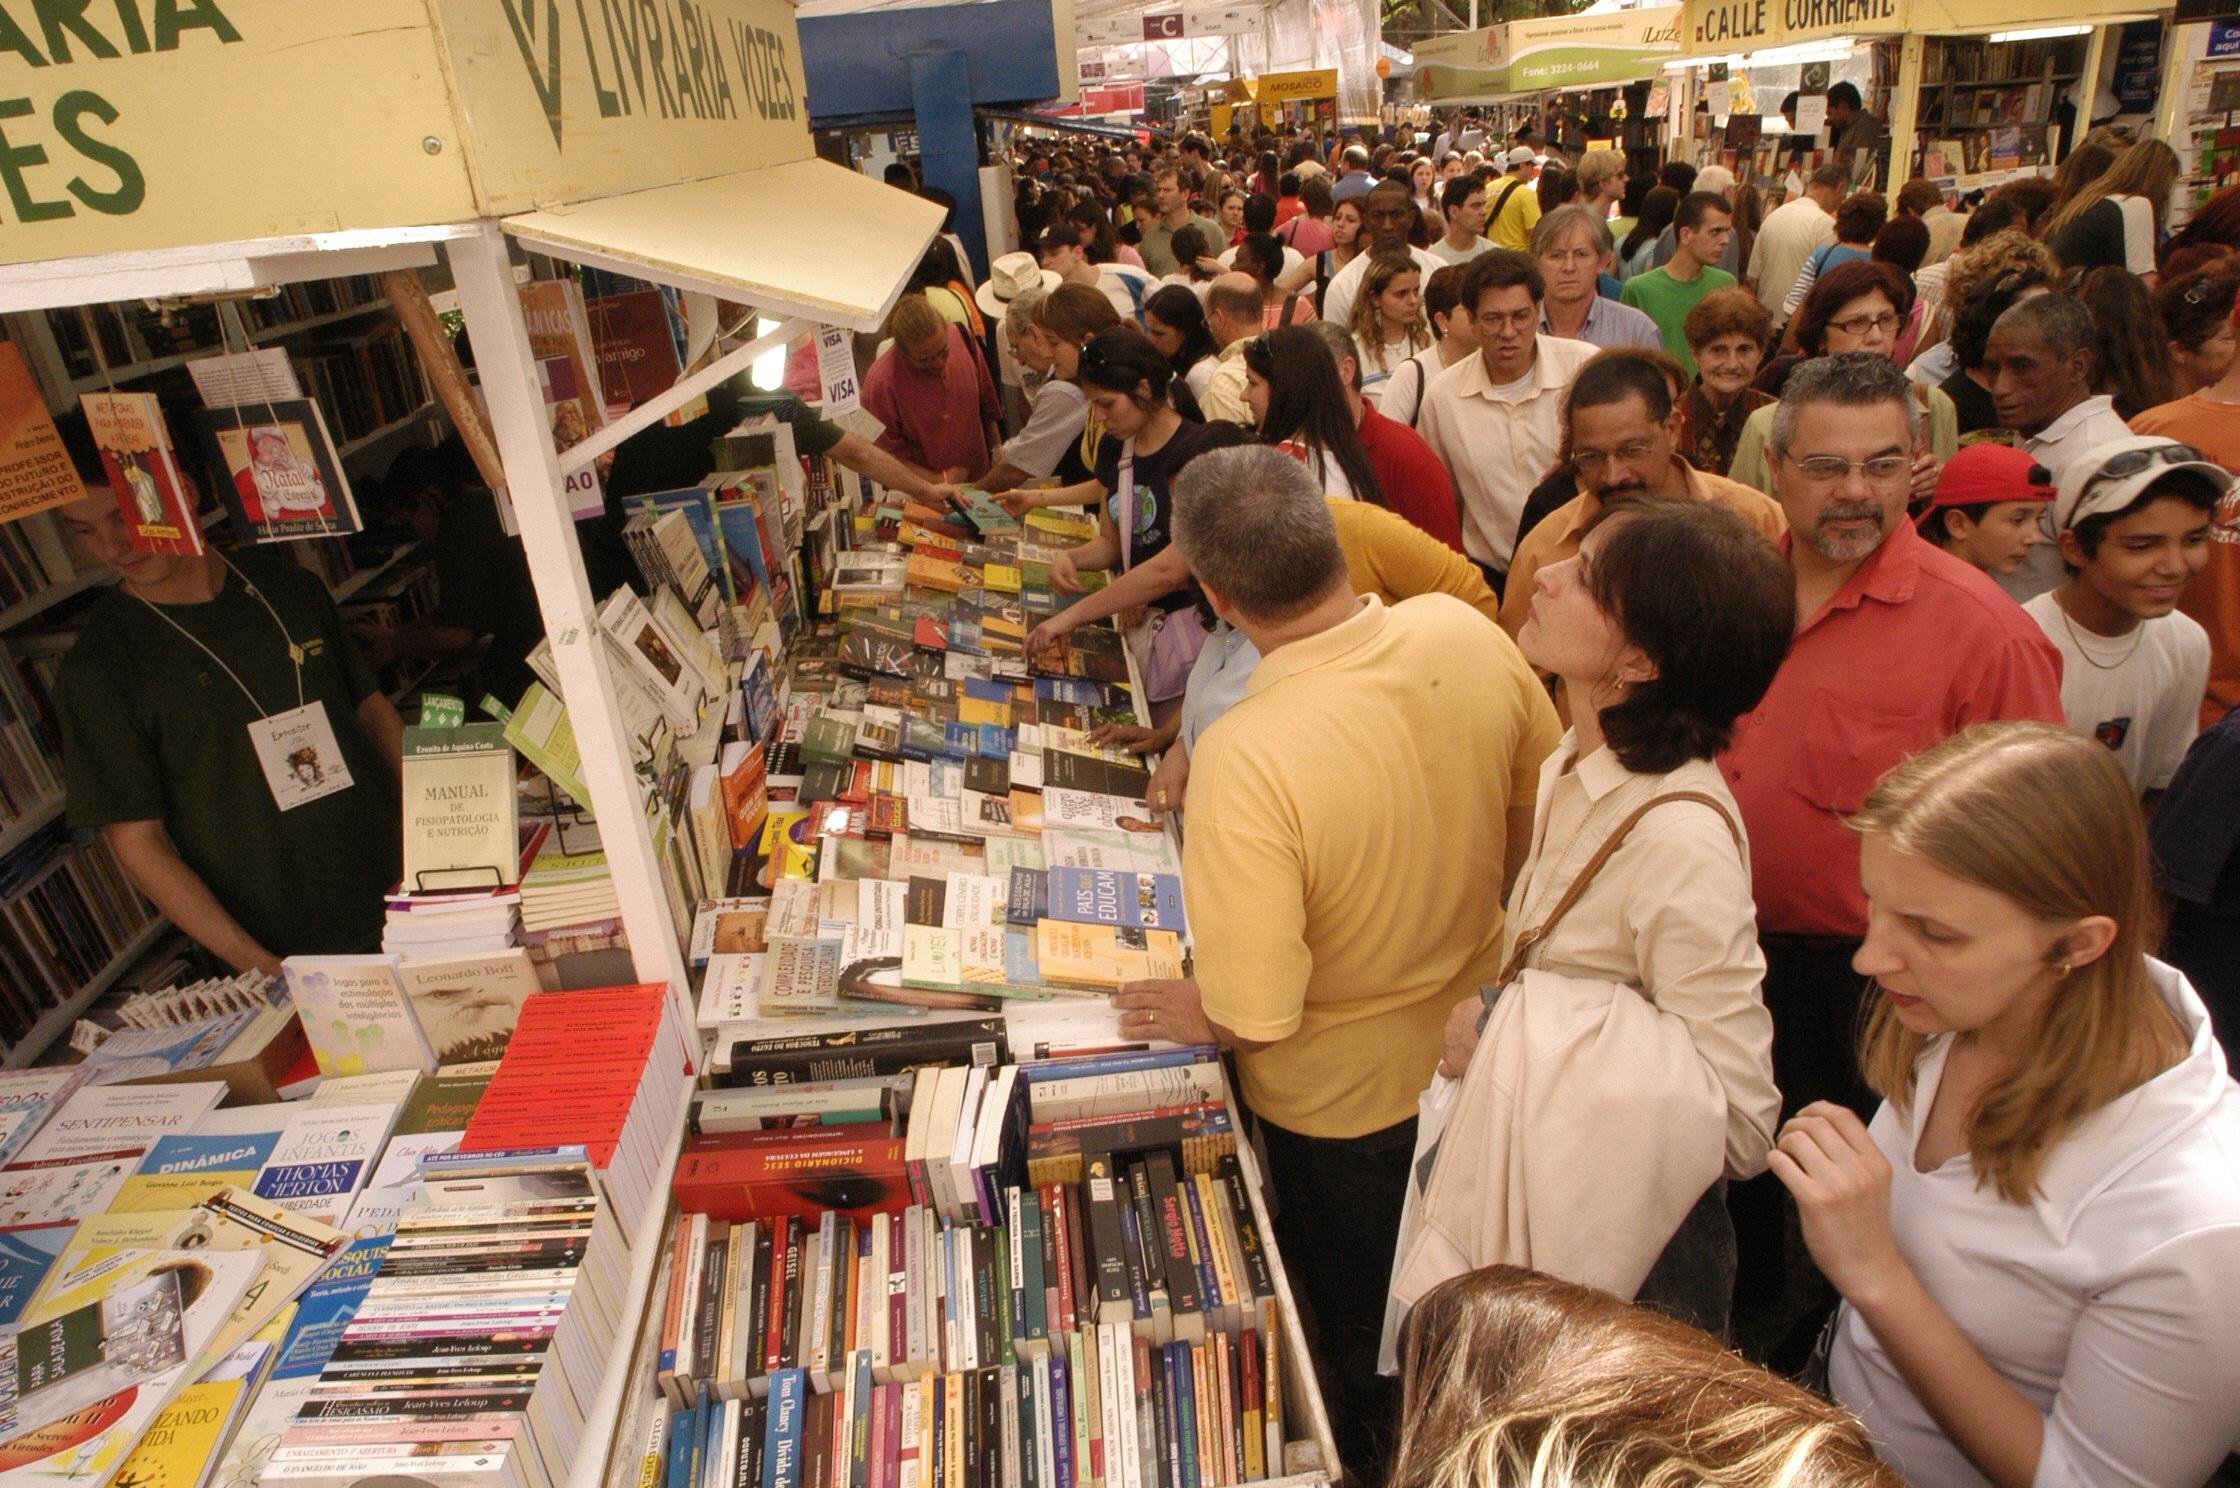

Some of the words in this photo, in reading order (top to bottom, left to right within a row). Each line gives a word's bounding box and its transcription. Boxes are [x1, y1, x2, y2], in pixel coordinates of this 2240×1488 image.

[1161, 16, 1177, 36] C
[1704, 0, 1766, 43] CALLE
[1785, 0, 1895, 31] CORRIENTE
[576, 0, 738, 120] LIVRARIA
[726, 17, 797, 122] VOZES
[1522, 64, 1548, 77] Fone:
[1269, 80, 1323, 94] MOSAICO
[822, 332, 842, 349] VISA
[605, 346, 646, 364] amigo
[829, 378, 855, 403] VISA
[15, 464, 58, 482] FUTURO
[56, 473, 73, 485] DO
[425, 783, 489, 801] MANUAL
[450, 802, 464, 813] DE
[415, 813, 500, 827] FISIOPATOLOGIA
[427, 828, 435, 838] E
[437, 825, 489, 838] NUTRIÇÃO
[1077, 890, 1094, 915] PAIS
[1096, 871, 1118, 921] EDUCAM
[416, 969, 481, 985] Leonardo
[484, 963, 514, 976] Boff
[774, 942, 798, 997] COMPLEXIDADE
[797, 947, 816, 985] PESQUISA
[333, 978, 358, 988] Jogos
[360, 978, 380, 988] para
[338, 999, 354, 1009] das
[751, 1043, 773, 1053] EGITO
[774, 1041, 784, 1051] DO
[785, 1039, 821, 1050] TESOUROS
[56, 1115, 182, 1131] SENTIPENSAR
[160, 1145, 257, 1174] DINÂMICA
[765, 1153, 799, 1162] CULTURA
[795, 1155, 864, 1169] DICIONÁRIO
[801, 1152, 810, 1160] DA
[811, 1149, 855, 1160] LINGUAGEM
[276, 1162, 351, 1183] THOMAS
[762, 1158, 790, 1171] SESC
[265, 1177, 344, 1198] MERTON
[1168, 1228, 1187, 1259] Motta
[786, 1246, 798, 1281] GEISEL
[30, 1361, 45, 1389] PARA
[780, 1374, 797, 1398] Tom
[318, 1400, 391, 1417] HESICASMO
[402, 1399, 453, 1410] Jean-Yves
[453, 1398, 488, 1409] Leloup
[775, 1398, 796, 1433] Clancy
[775, 1439, 794, 1475] Dívida
[290, 1464, 336, 1473] EVANGELHO
